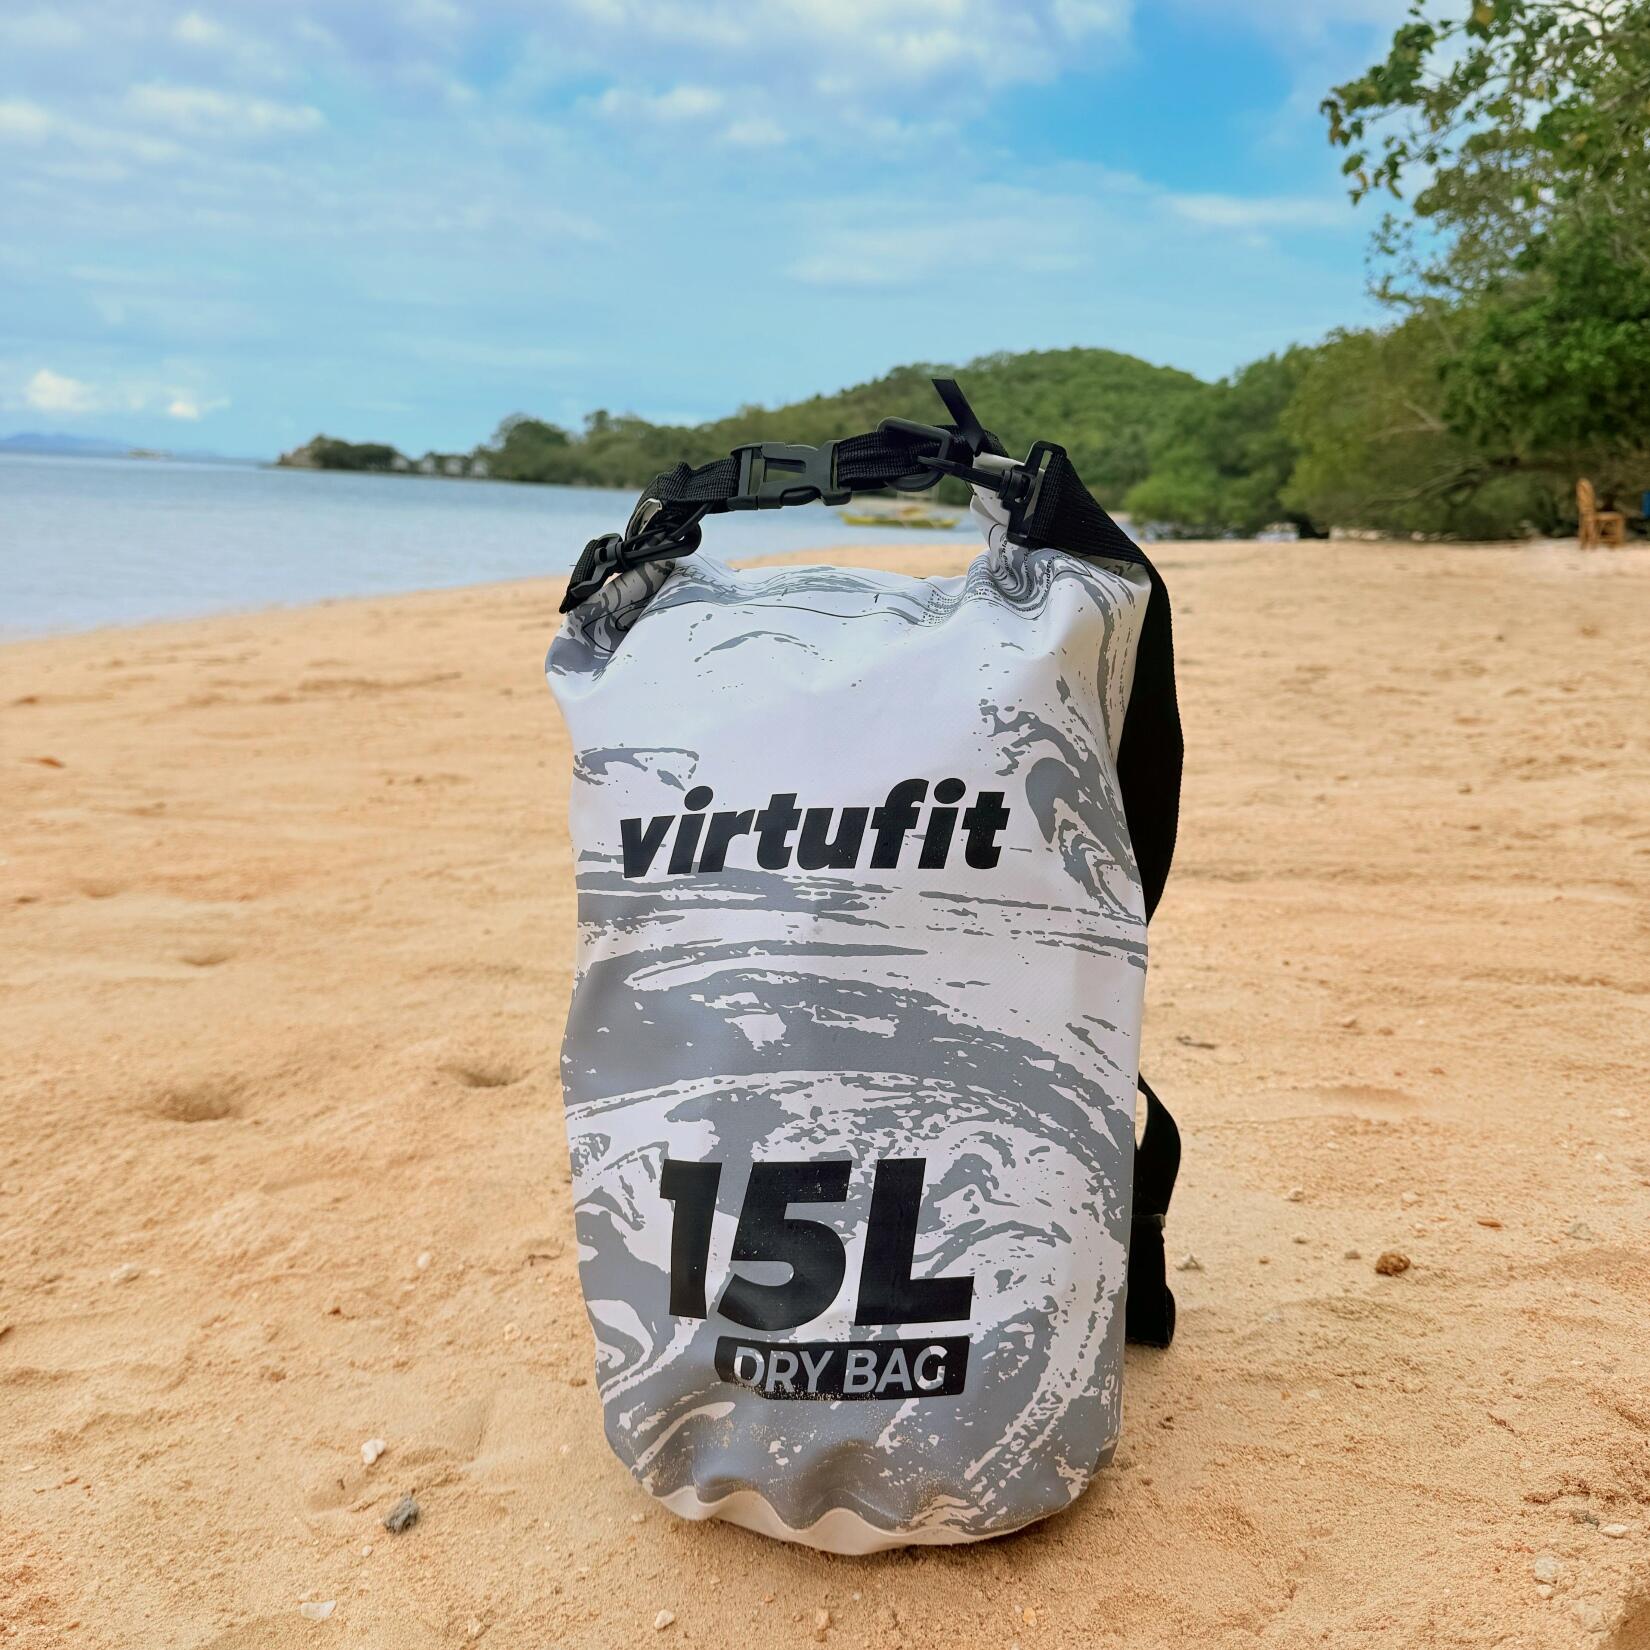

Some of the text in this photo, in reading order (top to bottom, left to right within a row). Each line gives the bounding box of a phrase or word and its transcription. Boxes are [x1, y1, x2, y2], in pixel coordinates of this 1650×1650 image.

[620, 778, 1011, 879] virtufit
[660, 1158, 974, 1331] 15L
[733, 1345, 948, 1394] DRY BAG
